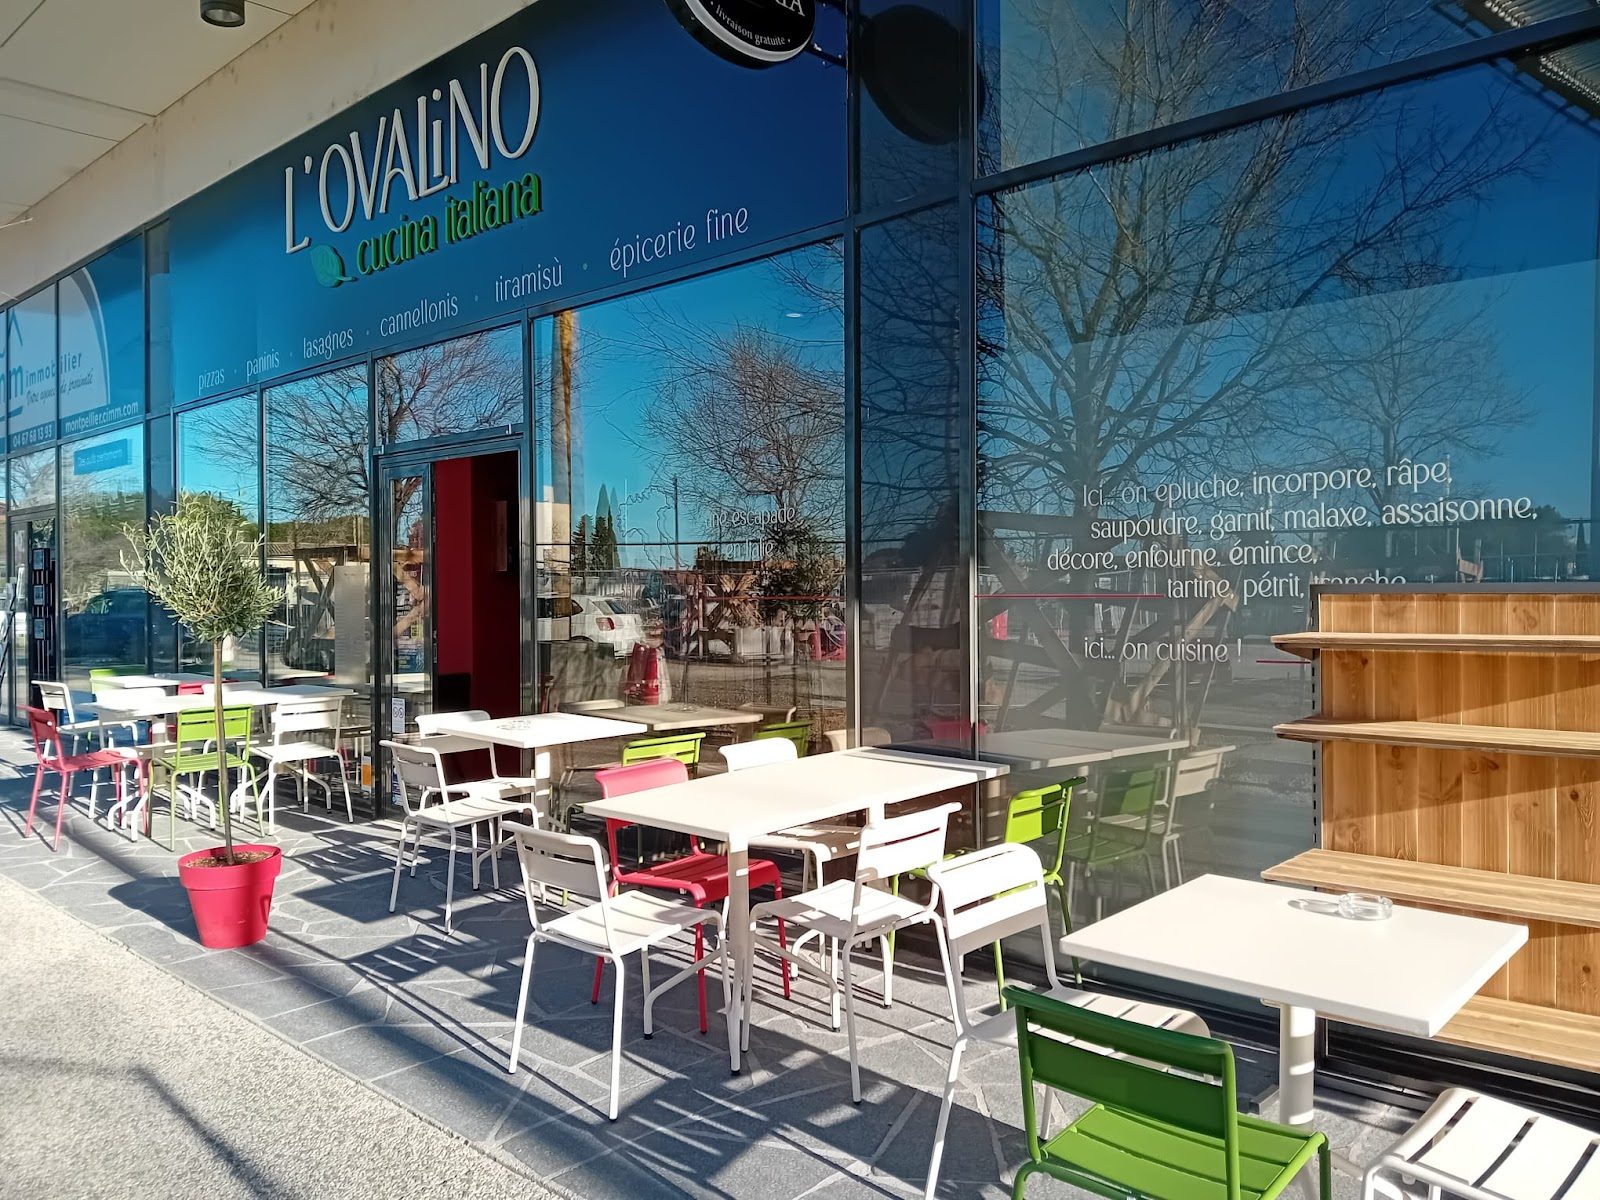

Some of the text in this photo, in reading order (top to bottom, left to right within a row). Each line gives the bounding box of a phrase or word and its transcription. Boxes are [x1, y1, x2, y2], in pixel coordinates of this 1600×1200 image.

[716, 4, 753, 40] livraison
[754, 33, 786, 46] gratuite
[356, 172, 543, 276] cucina italiana
[198, 206, 750, 396] pizzas paninis lasagnes cannellonis tiramisù épicerie fine
[65, 400, 139, 433] montpellier.cimm.com
[1121, 484, 1148, 504] on
[1252, 465, 1378, 499] incorpore,
[1386, 457, 1453, 492] râpe,
[731, 502, 796, 531] escapade
[1090, 496, 1539, 544] saupoudre, garnit, malaxe, assaisonne,
[725, 542, 742, 559] en
[1047, 539, 1319, 571] décore, enfourne, émince,
[1167, 574, 1235, 599] tartine,
[1243, 570, 1305, 606] pétrit,
[1122, 641, 1149, 661] on
[1156, 638, 1229, 663] cuisine
